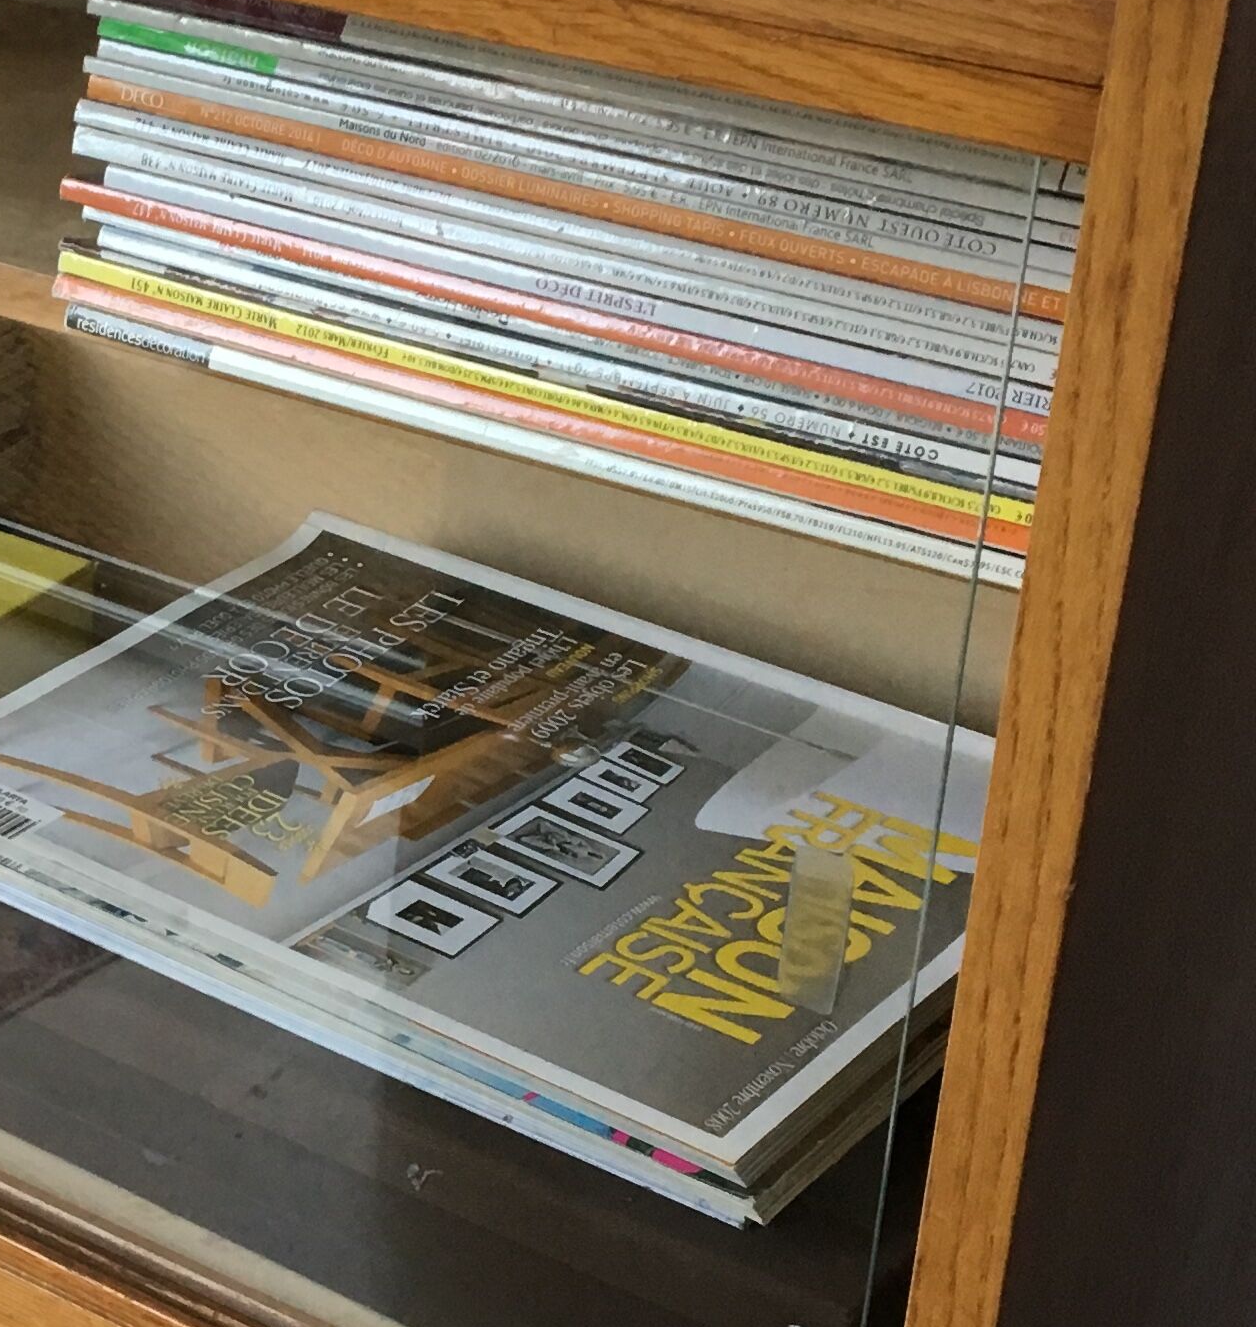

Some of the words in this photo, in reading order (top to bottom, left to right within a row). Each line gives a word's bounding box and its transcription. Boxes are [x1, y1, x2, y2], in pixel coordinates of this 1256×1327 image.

[338, 116, 381, 137] Maisons
[383, 127, 397, 141] du
[399, 131, 426, 148] Nord
[803, 220, 840, 241] France
[843, 229, 873, 249] SARL
[839, 156, 878, 176] France
[460, 163, 515, 190] DOSSIER
[519, 177, 597, 209] LUMINAIRES
[612, 199, 680, 229] SHOPPING
[686, 214, 724, 238] TAPIS
[738, 226, 775, 250] FEUX
[778, 234, 844, 265] OUVERTS
[860, 254, 940, 289] ESCAPADE
[130, 276, 149, 294] 451
[165, 285, 203, 308] MAISON
[535, 273, 576, 300] DÉCO
[206, 296, 242, 318] CLAIRE
[244, 306, 277, 328] MARIE
[583, 285, 655, 320] L'ESPRIT
[295, 320, 320, 339] 2012
[750, 404, 767, 422] 56
[861, 431, 888, 452] EST
[319, 586, 384, 617] LE
[384, 589, 465, 631] LES
[257, 624, 363, 683] ENTRENT
[483, 625, 563, 671] Trigano
[526, 636, 580, 668] L'hôtel
[597, 652, 626, 667] en
[258, 627, 407, 710] PHOTOS
[464, 669, 494, 683] et
[468, 665, 534, 704] populaire
[607, 658, 648, 682] Les
[196, 680, 273, 720] DANS
[408, 681, 481, 722] Starck
[451, 702, 480, 717] de
[504, 666, 606, 733] avant-première
[562, 677, 621, 712] objets
[160, 772, 258, 827] CUISINE
[245, 811, 306, 842] 23
[578, 791, 869, 1008] FRANÇAISE
[658, 812, 981, 1045] MAISON
[790, 1020, 838, 1056] Octobre
[737, 1057, 795, 1107] Novembre
[704, 1102, 741, 1132] 2008
